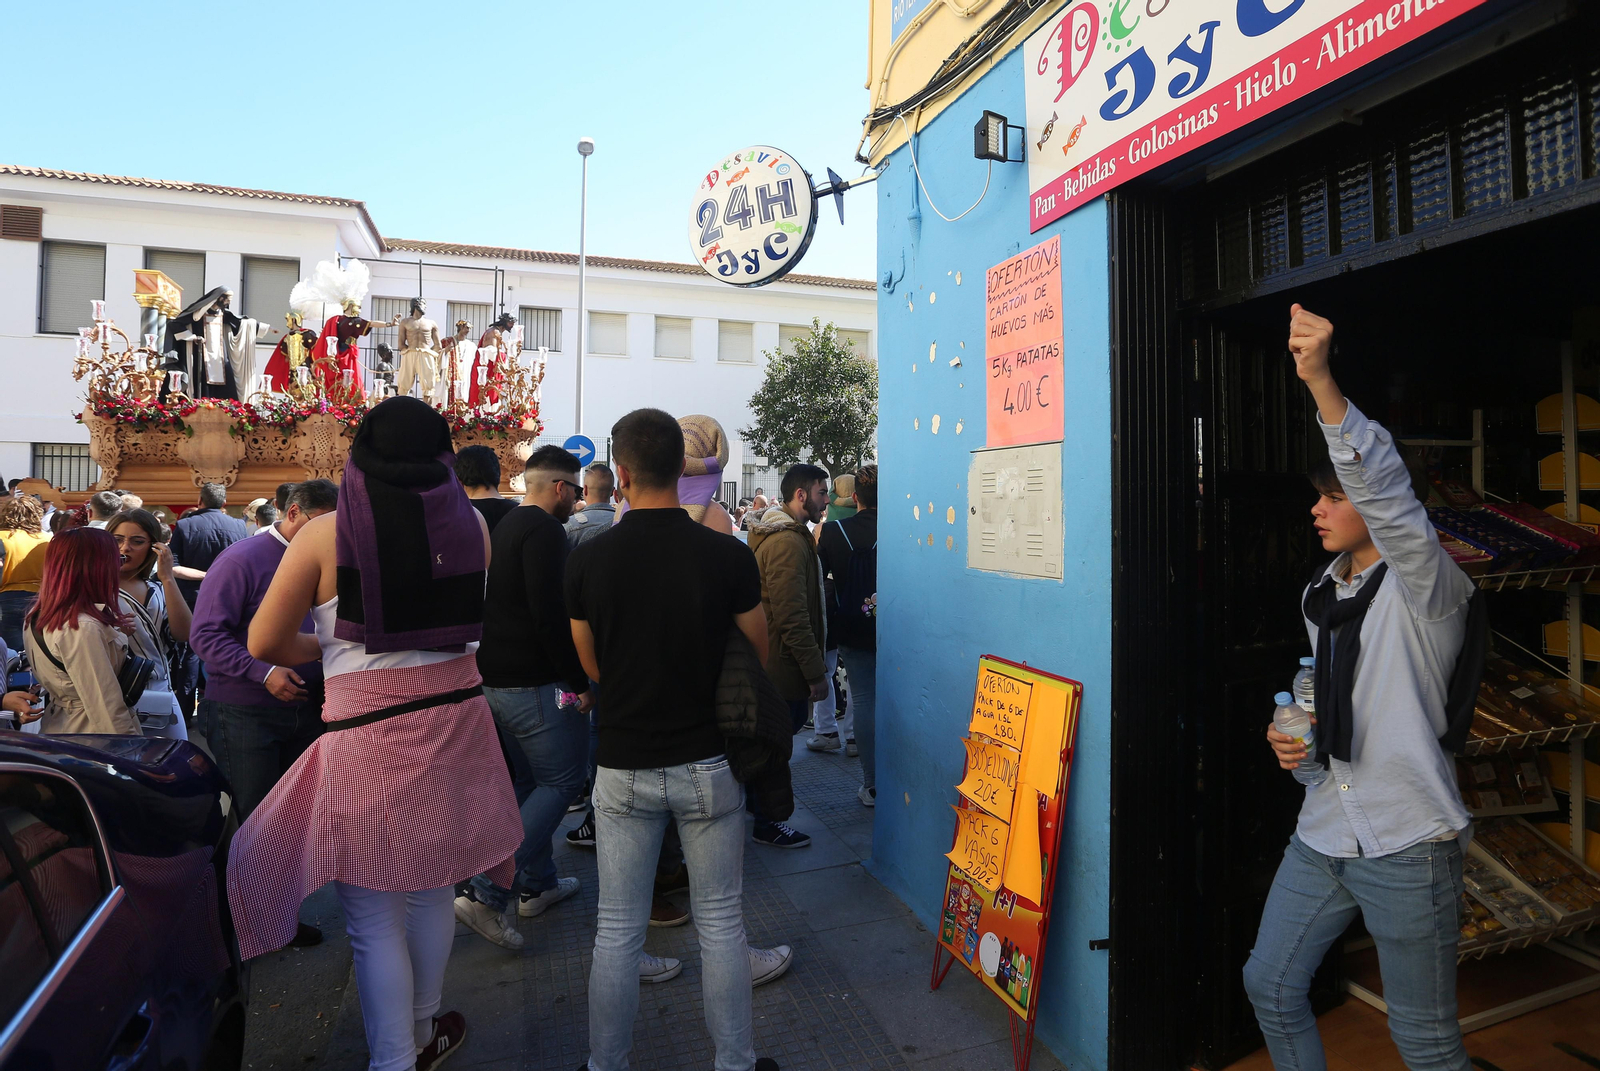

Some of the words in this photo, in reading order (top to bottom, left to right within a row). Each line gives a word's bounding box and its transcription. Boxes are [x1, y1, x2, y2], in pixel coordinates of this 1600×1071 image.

[1034, 194, 1056, 219] Pan
[1064, 155, 1116, 201] Bebidas
[1128, 101, 1219, 165] Golosinas
[1234, 57, 1297, 112] Hielo
[701, 150, 790, 191] Desavio
[696, 178, 797, 248] 24H
[716, 232, 789, 276] JyC
[989, 293, 1027, 321] CARTÓN
[1034, 283, 1047, 301] DE
[990, 314, 1027, 340] HUEVOS
[1033, 302, 1055, 325] MÁS
[1016, 342, 1060, 370] PATATAS
[978, 691, 994, 706] PACK
[997, 700, 1005, 710] DE
[1009, 704, 1013, 713] 6
[1015, 706, 1024, 716] DE
[983, 674, 1020, 695] OFERTON
[959, 808, 988, 839] PACK
[991, 828, 999, 845] 6
[965, 835, 999, 875] VASOS
